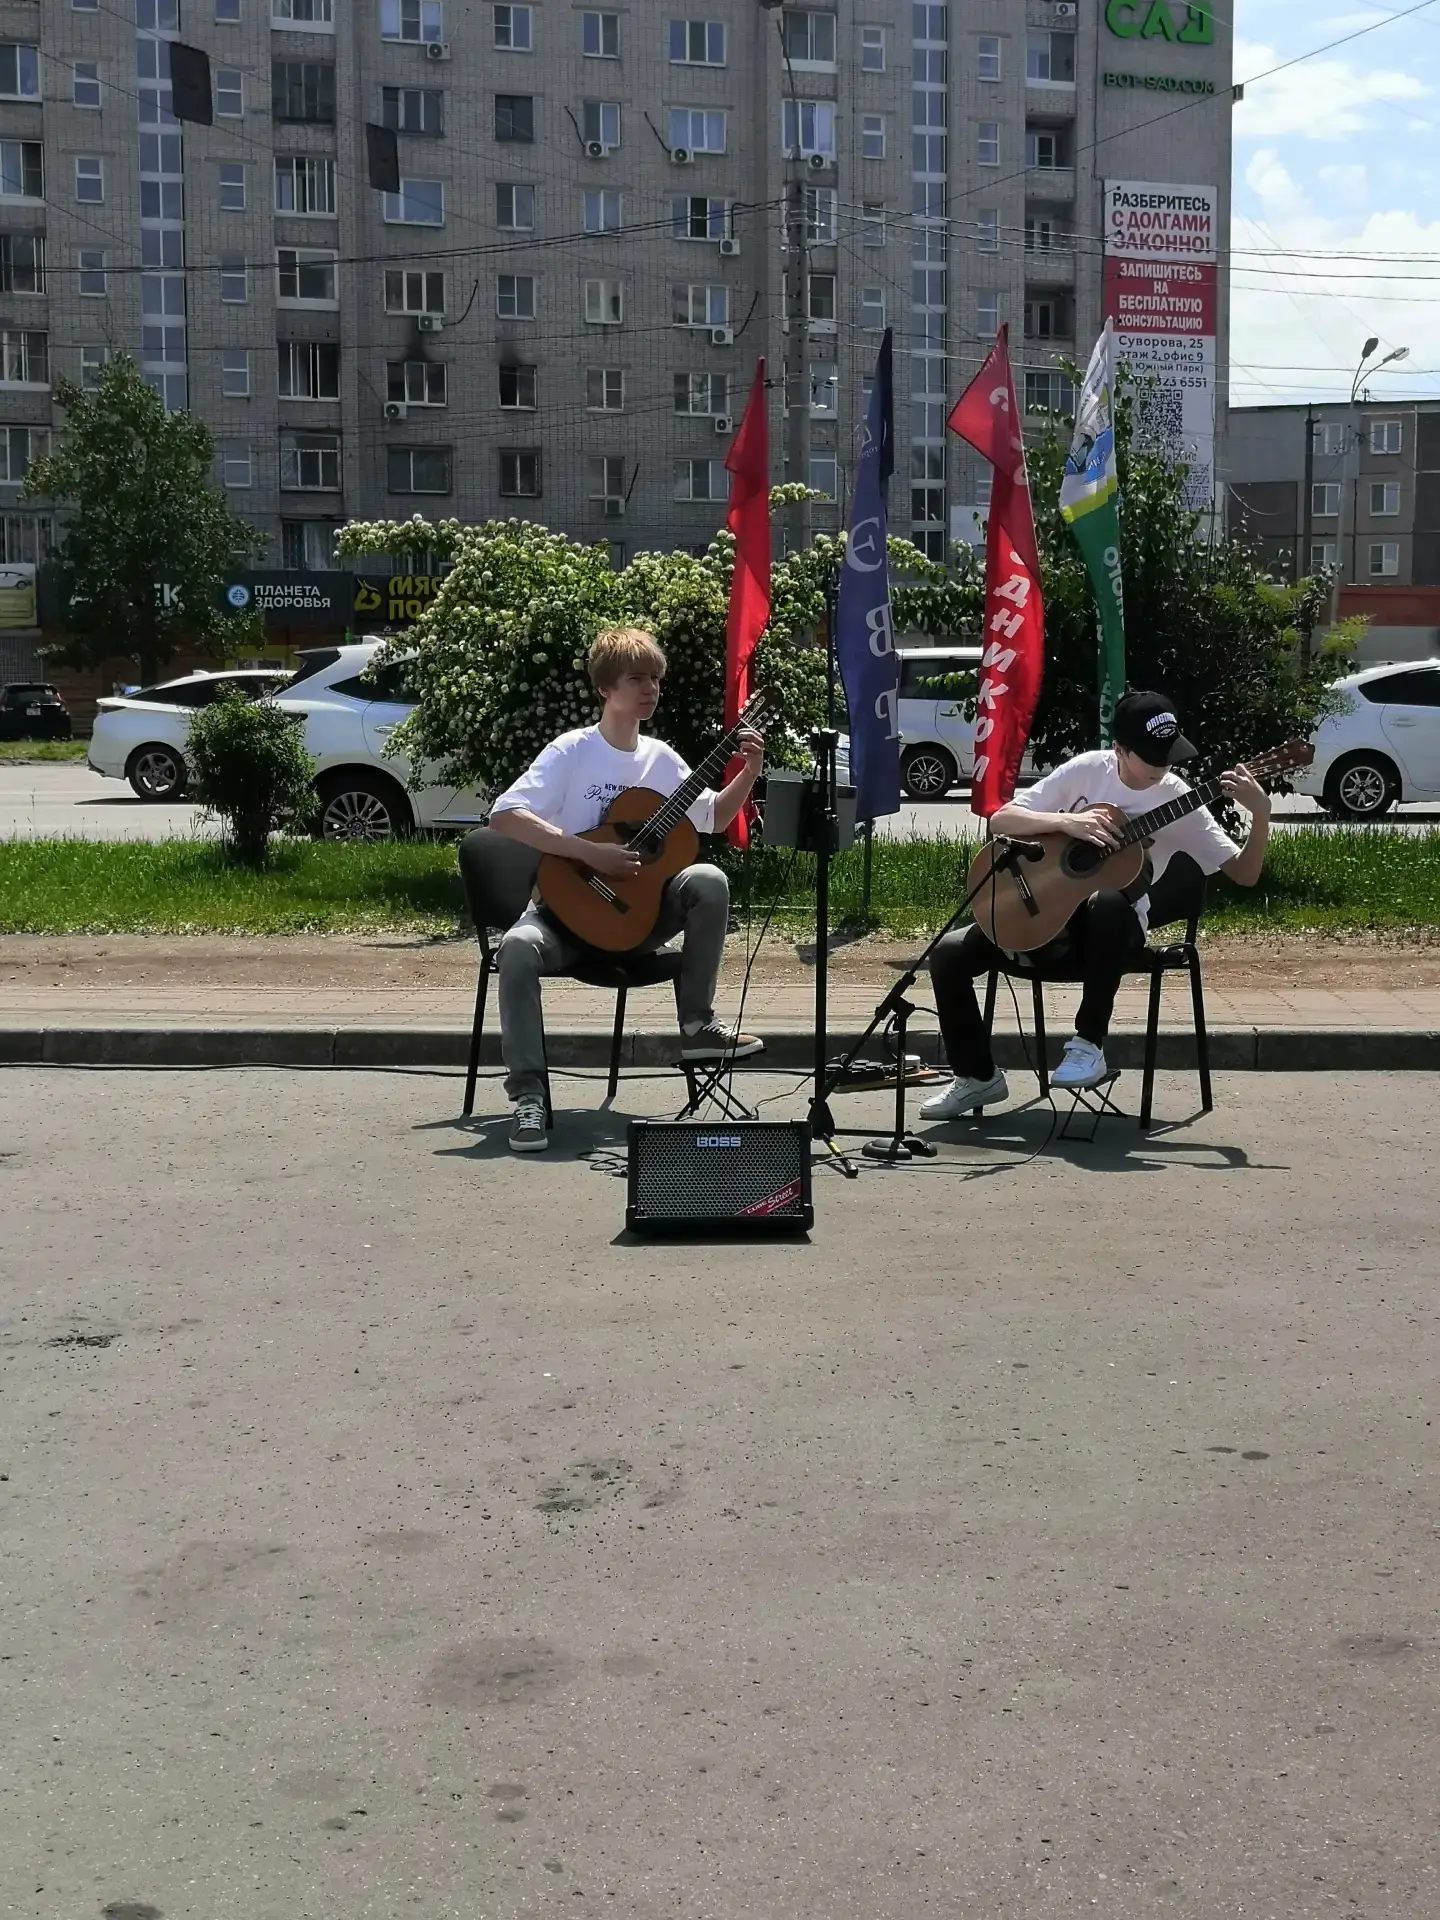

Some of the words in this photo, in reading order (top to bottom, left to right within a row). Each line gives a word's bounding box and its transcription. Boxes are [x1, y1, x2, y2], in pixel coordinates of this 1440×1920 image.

[1112, 192, 1211, 212] РАЗБЕРИТЕСЬ
[1111, 210, 1124, 227] С
[1127, 211, 1211, 232] ДОЛГАМИ
[1113, 231, 1211, 255] ЗАКОННО!
[1119, 262, 1202, 281] ЗАПИШИТЕСЬ
[1153, 281, 1169, 294] НА
[1119, 295, 1203, 312] БЕСПЛАТНУЮ
[1119, 314, 1203, 331] КОНСУЛЬТАЦИЮ
[1118, 335, 1186, 350] Суворова,
[1189, 338, 1204, 349] 25
[1119, 350, 1149, 359] этаж
[1163, 350, 1195, 362] офис
[1196, 352, 1204, 362] 9
[1175, 363, 1204, 374] Парк)
[1180, 376, 1207, 388] 6551
[254, 585, 321, 596] ПЛАНЕТА
[255, 597, 331, 609] ЗДОРОВЬЯ
[696, 1136, 741, 1147] BOSS
